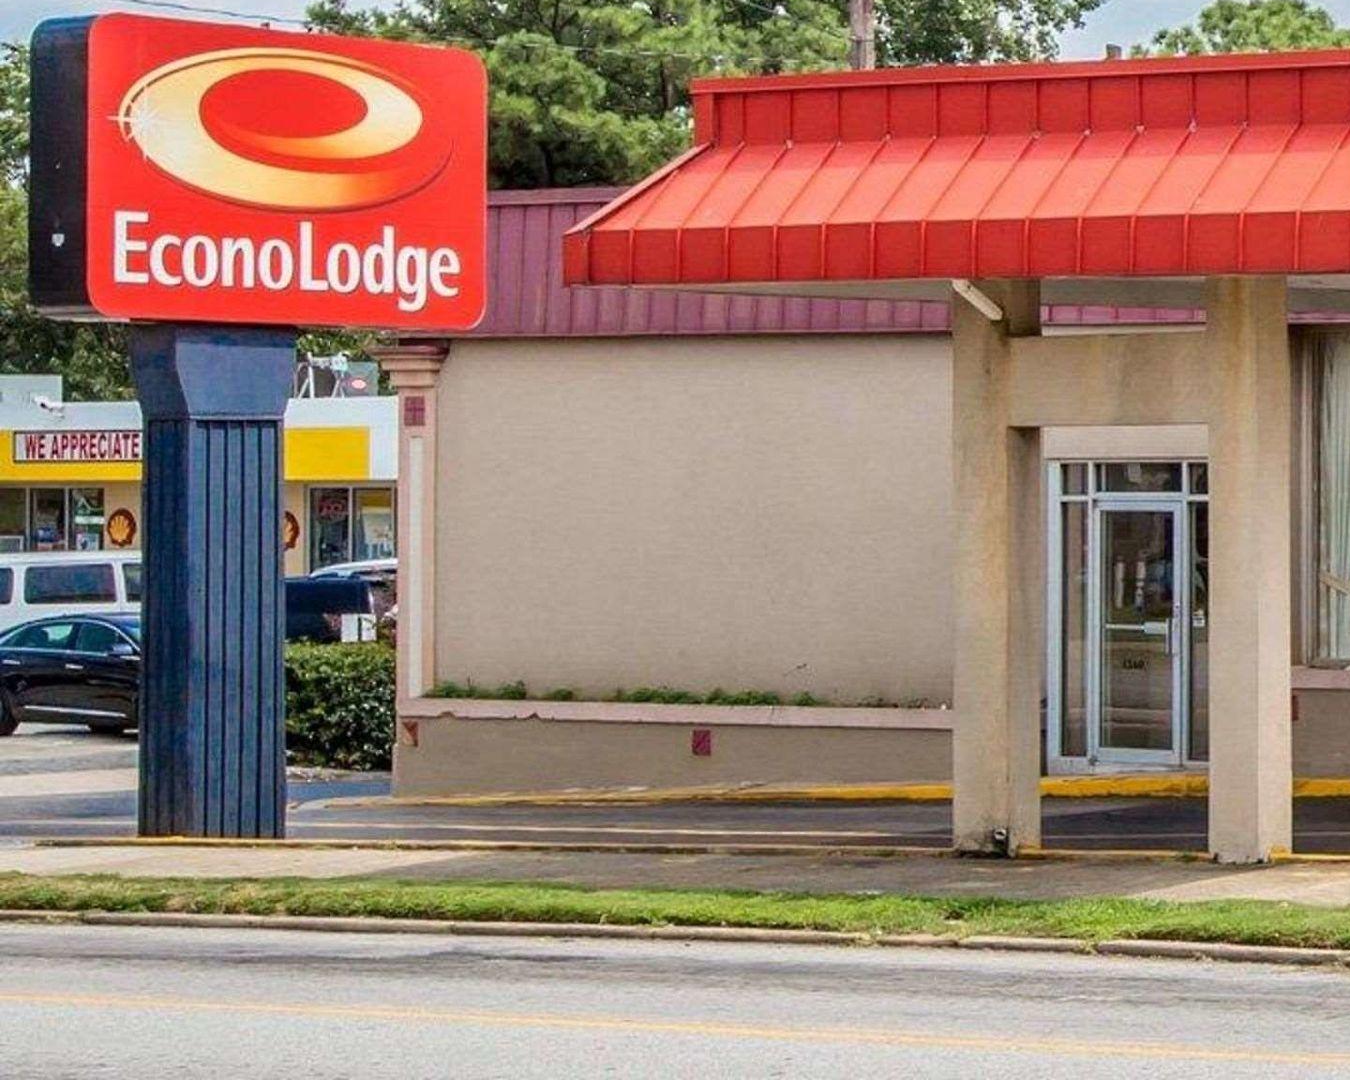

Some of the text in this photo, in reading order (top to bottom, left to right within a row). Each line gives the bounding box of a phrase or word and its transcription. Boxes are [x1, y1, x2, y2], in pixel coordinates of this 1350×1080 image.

[113, 210, 461, 312] EconoLodge
[26, 433, 140, 459] WE APPRECIATE
